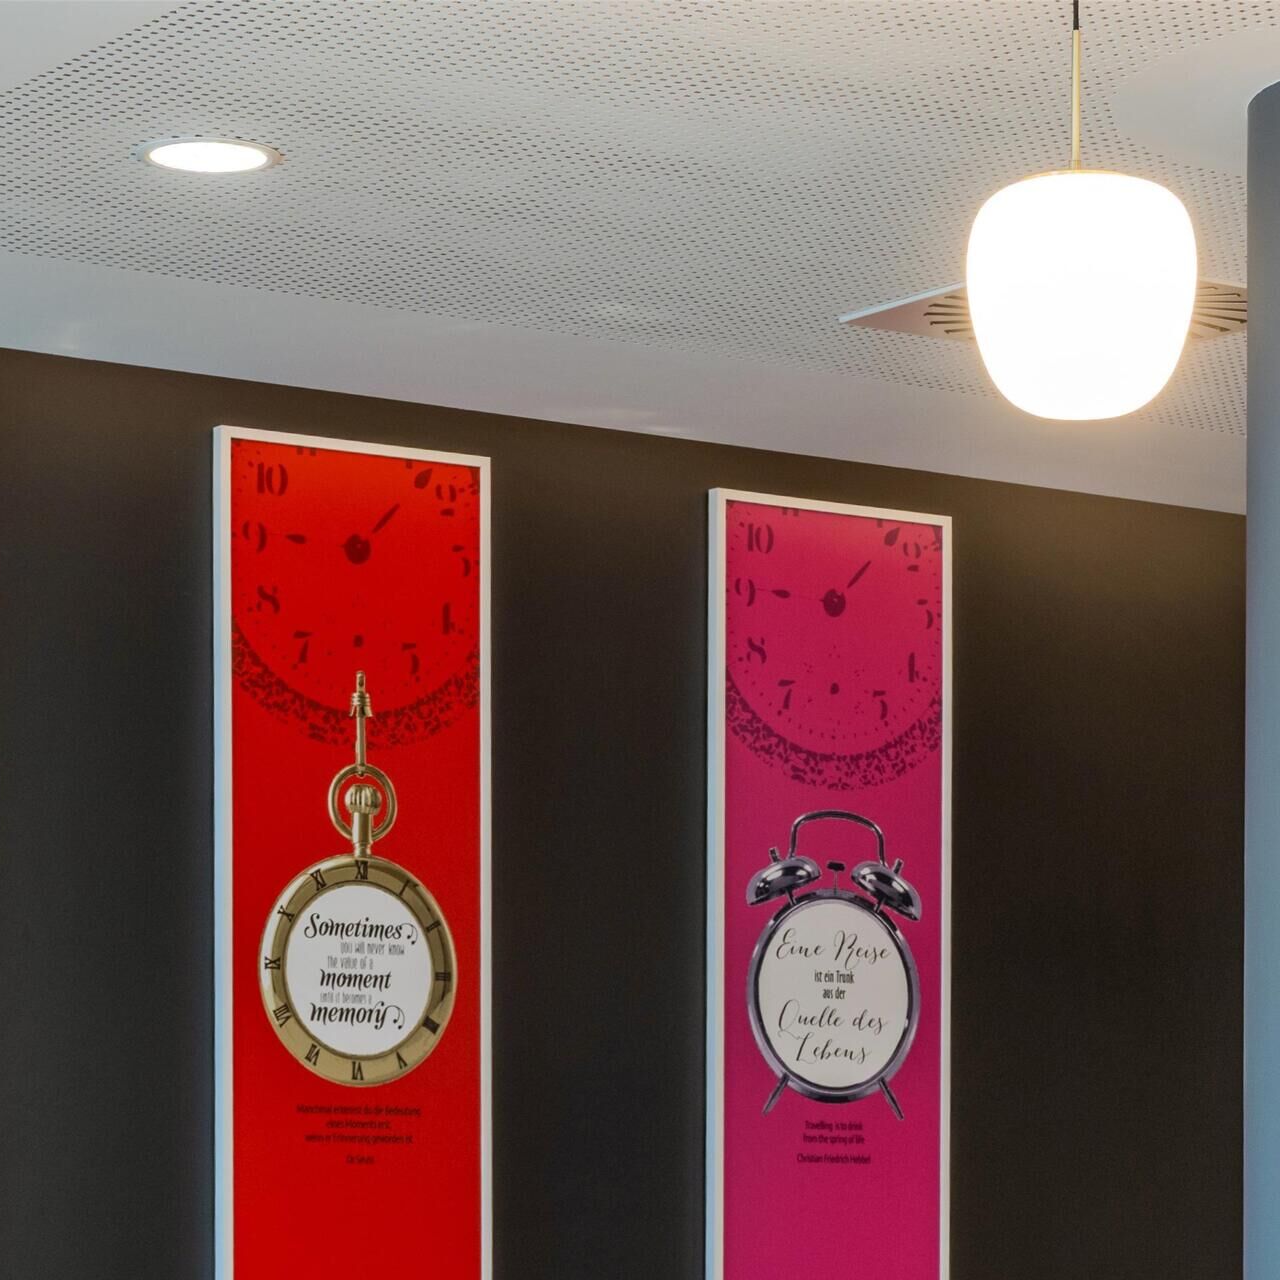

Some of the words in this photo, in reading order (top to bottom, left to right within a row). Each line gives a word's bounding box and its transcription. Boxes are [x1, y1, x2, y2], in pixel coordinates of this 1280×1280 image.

[257, 462, 289, 496] 10
[747, 523, 774, 554] 10
[304, 912, 418, 945] Sometimes
[775, 928, 825, 960] Eine
[834, 929, 891, 969] Reise
[320, 968, 392, 992] moment
[814, 970, 823, 983] ist
[824, 969, 835, 983] ein
[836, 969, 855, 984] Trunk
[822, 988, 834, 999] aus
[835, 986, 846, 999] der
[310, 1001, 406, 1031] memory
[777, 999, 845, 1040] Quelle
[852, 1009, 889, 1035] des
[795, 1031, 872, 1064] Lebens
